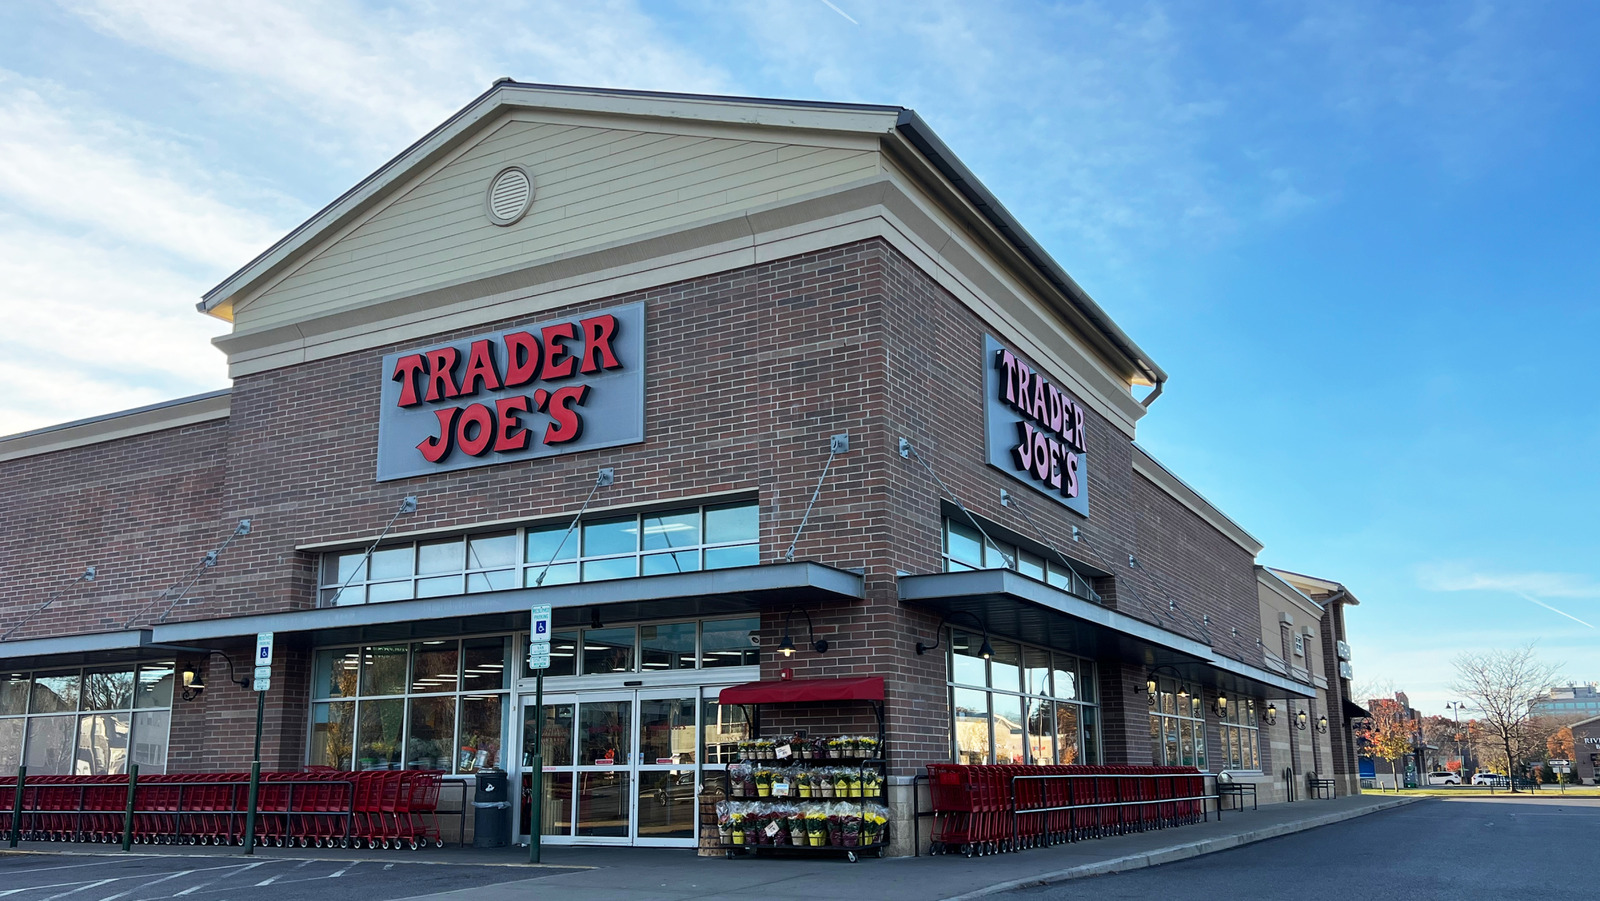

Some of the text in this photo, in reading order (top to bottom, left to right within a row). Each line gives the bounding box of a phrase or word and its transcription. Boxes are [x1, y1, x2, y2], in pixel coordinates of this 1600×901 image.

[392, 313, 623, 407] TRADER
[995, 349, 1087, 453] TRADER
[415, 384, 591, 463] JOE'S
[1011, 421, 1079, 498] JOE'S
